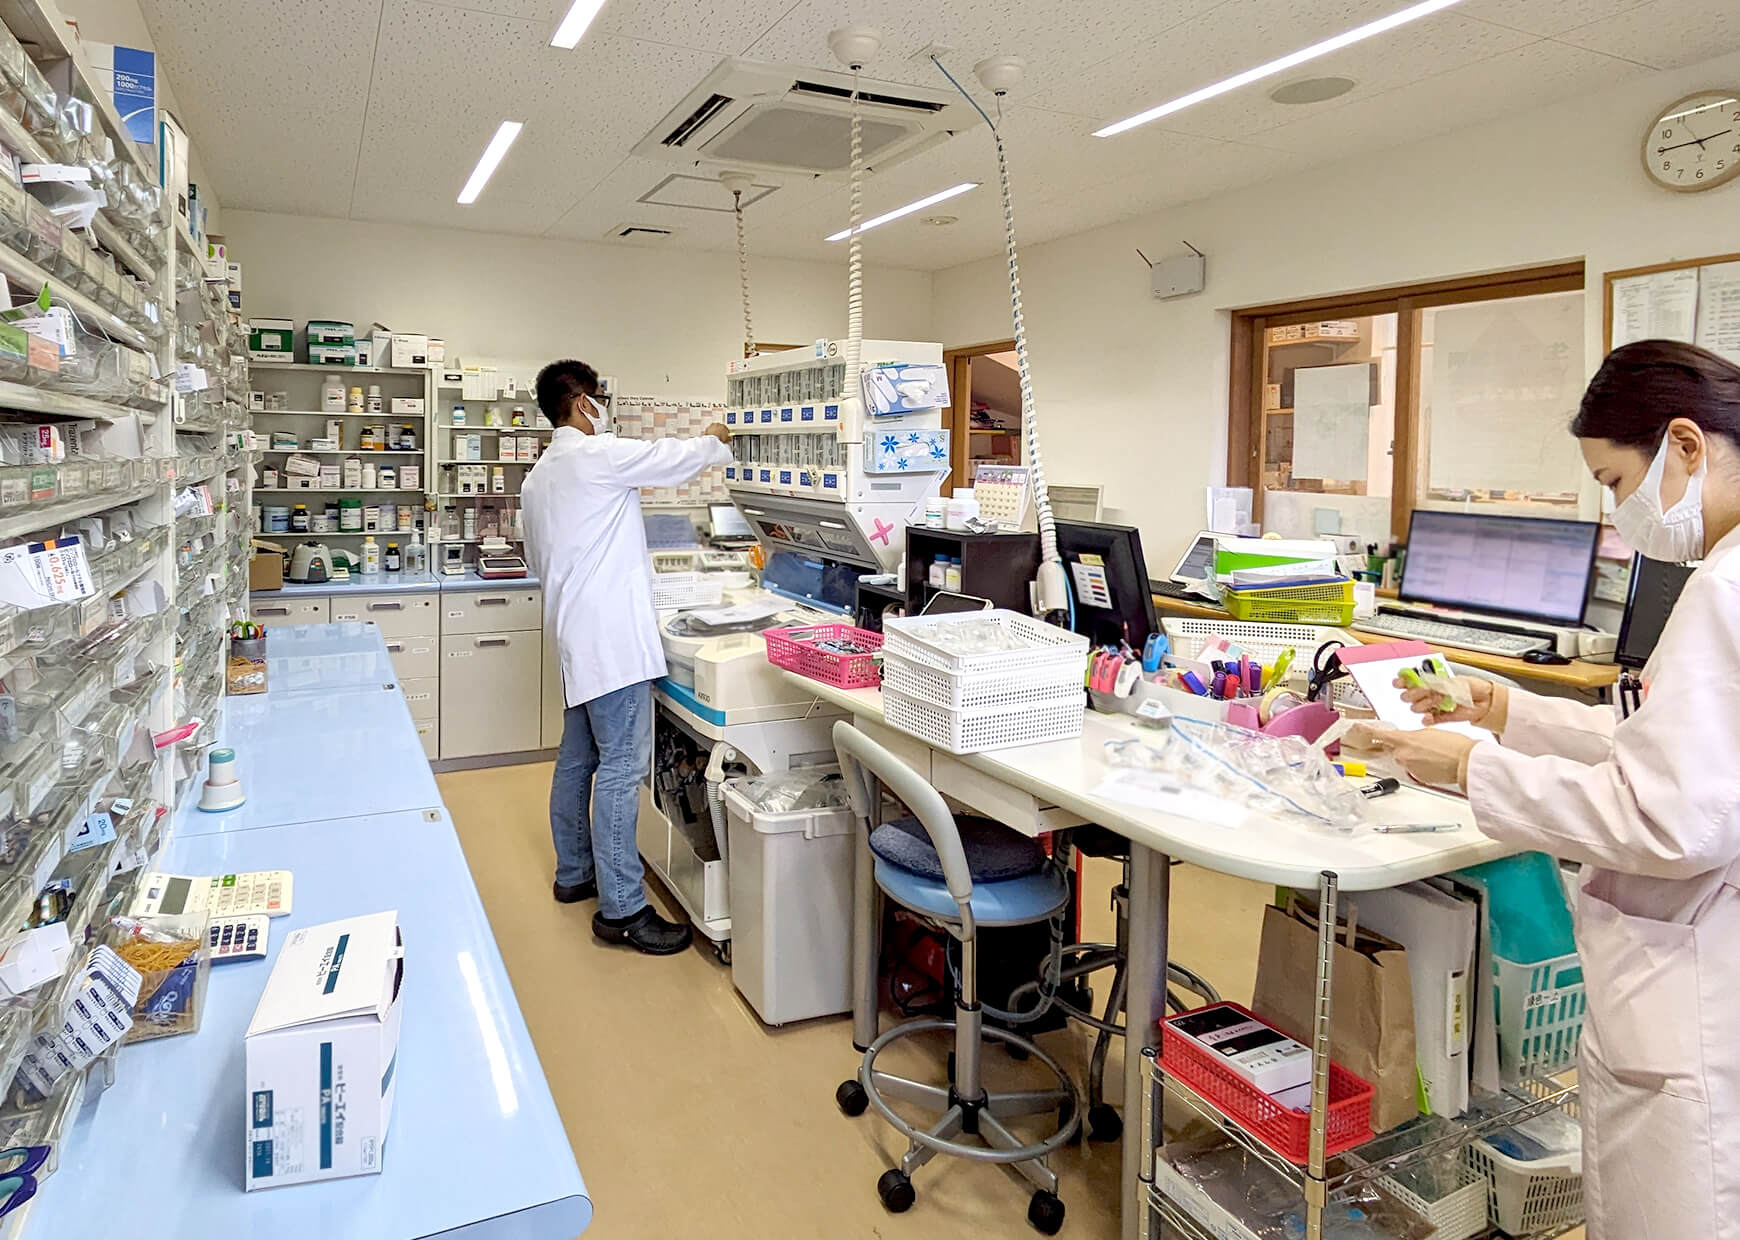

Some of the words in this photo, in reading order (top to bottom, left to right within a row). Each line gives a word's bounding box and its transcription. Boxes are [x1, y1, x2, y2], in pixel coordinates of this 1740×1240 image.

[1662, 128, 1672, 139] 10
[1663, 161, 1671, 171] 8
[1716, 159, 1725, 170] 5
[1677, 169, 1684, 179] 7
[1695, 169, 1704, 179] 6
